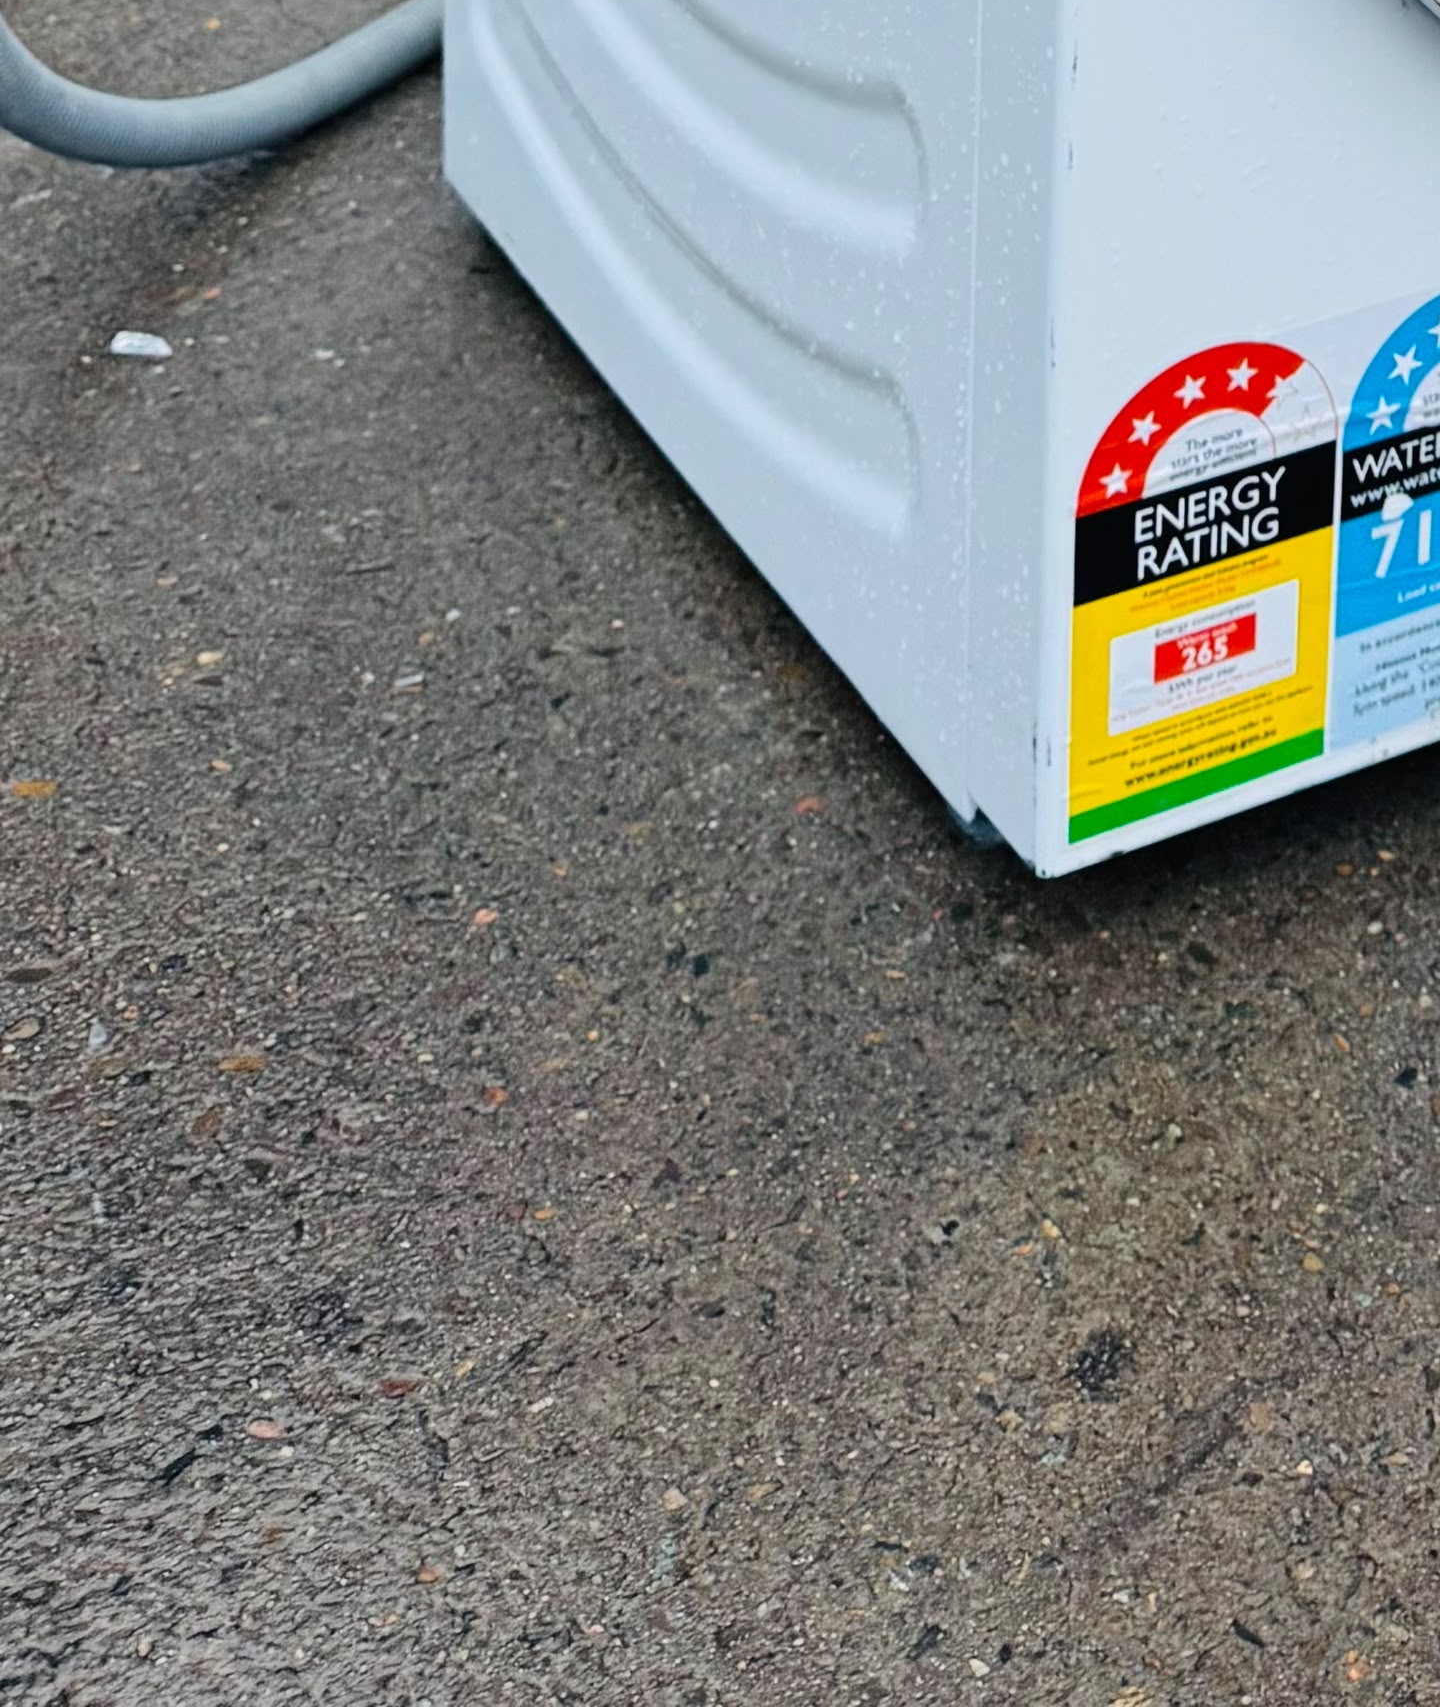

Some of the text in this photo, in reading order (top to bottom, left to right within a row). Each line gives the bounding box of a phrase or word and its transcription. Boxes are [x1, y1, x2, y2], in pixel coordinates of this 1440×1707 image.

[1171, 437, 1257, 469] stars the more
[1185, 428, 1243, 452] The more
[1134, 465, 1286, 544] ENERGY
[1137, 506, 1280, 581] RATING
[1181, 635, 1229, 672] 265
